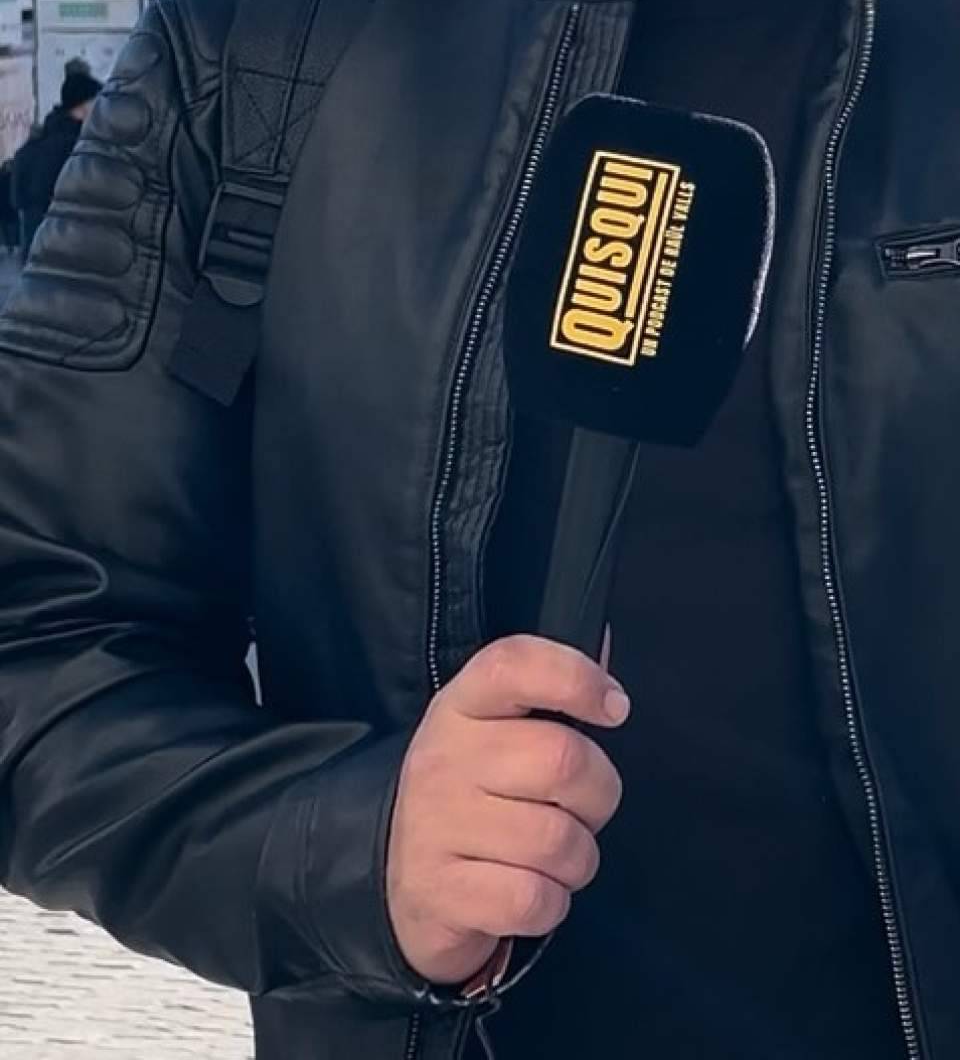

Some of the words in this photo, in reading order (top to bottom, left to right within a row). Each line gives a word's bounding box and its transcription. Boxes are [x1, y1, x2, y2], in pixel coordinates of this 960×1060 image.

[671, 180, 697, 220] VALLS
[560, 161, 654, 352] QUISQUI
[659, 259, 677, 278] DE
[645, 278, 673, 338] PODCAST
[640, 338, 659, 357] UN
